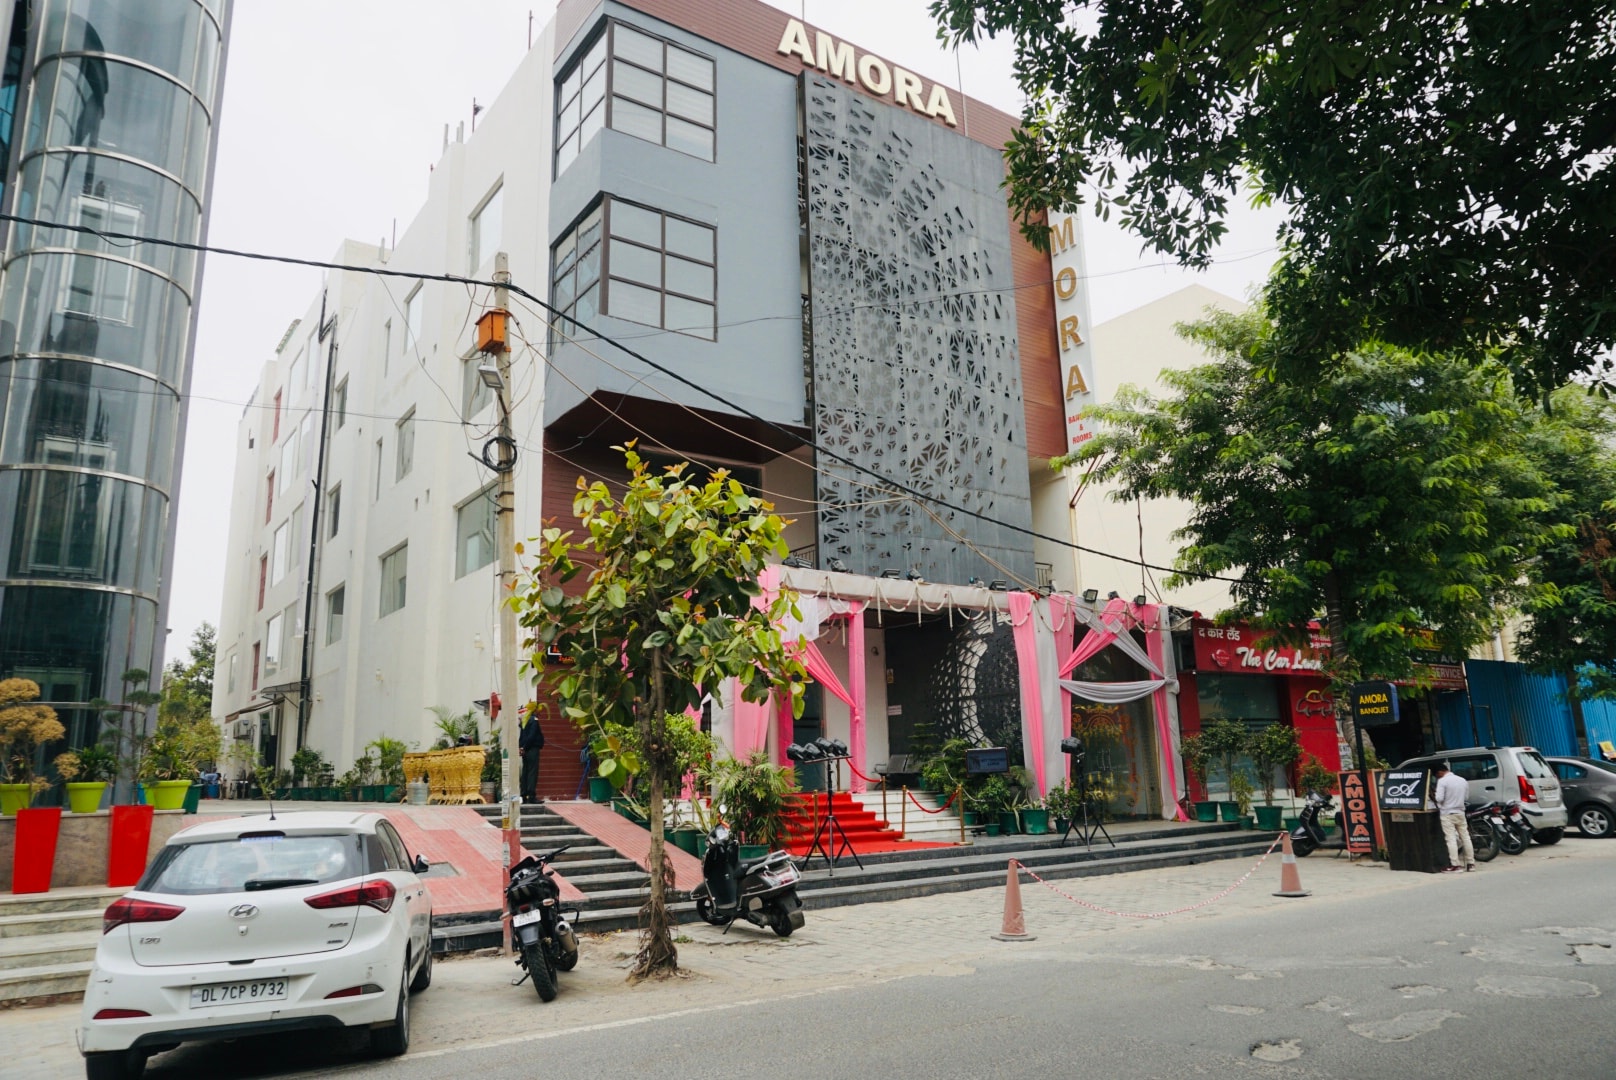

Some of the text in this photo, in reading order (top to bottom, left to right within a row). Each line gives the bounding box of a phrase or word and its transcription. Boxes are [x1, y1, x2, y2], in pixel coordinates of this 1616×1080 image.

[777, 18, 957, 128] AMORA
[1050, 216, 1090, 400] MORA
[1072, 431, 1093, 444] ROOMS
[1236, 646, 1262, 667] The
[1264, 649, 1290, 671] Car
[1360, 693, 1388, 704] AMORA
[1360, 706, 1389, 715] BANQUET
[1345, 774, 1370, 836] AMORA
[201, 982, 285, 1002] DL 7CP 8732
